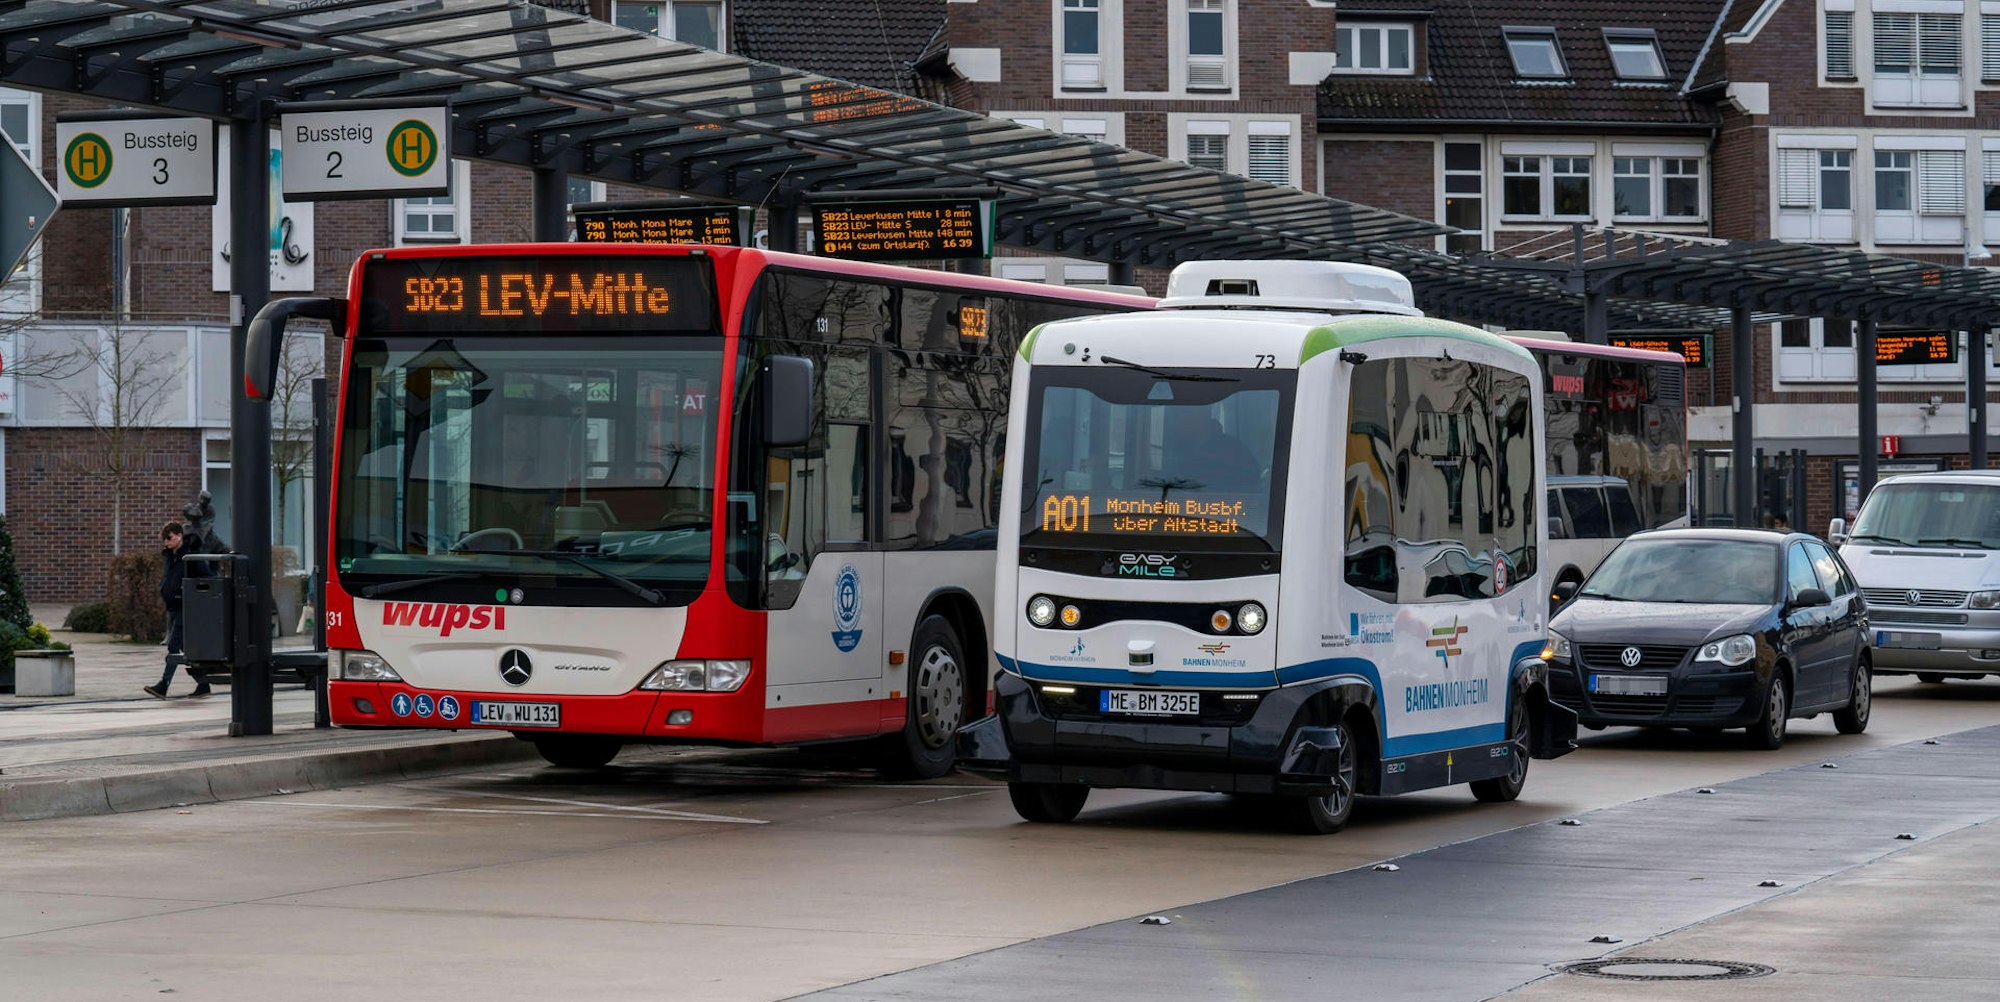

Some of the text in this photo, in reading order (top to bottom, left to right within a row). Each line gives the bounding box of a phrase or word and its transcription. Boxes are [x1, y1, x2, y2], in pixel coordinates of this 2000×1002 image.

[124, 131, 198, 151] Bussteig
[296, 124, 373, 144] Bussteig
[153, 158, 169, 185] 3
[327, 151, 343, 178] 2
[585, 221, 605, 231] 790
[641, 219, 666, 228] Mona
[669, 218, 693, 227] Mare
[711, 216, 730, 225] min
[821, 212, 848, 221] SB23
[850, 211, 904, 220] Leverkusen
[953, 209, 972, 218] min
[586, 231, 606, 240] 790
[642, 229, 668, 238] Mona
[670, 228, 694, 237] Mare
[705, 226, 712, 235] 6
[712, 226, 731, 235] min
[822, 221, 849, 231] SB23
[954, 219, 973, 228] min
[713, 235, 732, 244] min
[823, 231, 850, 241] SB23
[851, 230, 906, 240] Leverkusen
[955, 228, 973, 238] min
[405, 272, 670, 316] SB23 LEV-Mitte
[816, 316, 829, 333] 131
[1255, 354, 1276, 369] 73
[1043, 495, 1090, 532] A01
[1106, 498, 1246, 516] Monheim Busbf.
[1113, 516, 1239, 534] über Altstadt
[1110, 692, 1129, 710] ME
[1138, 693, 1158, 711] BM
[1161, 694, 1198, 712] 325E
[480, 704, 558, 722] LEV WU 131
